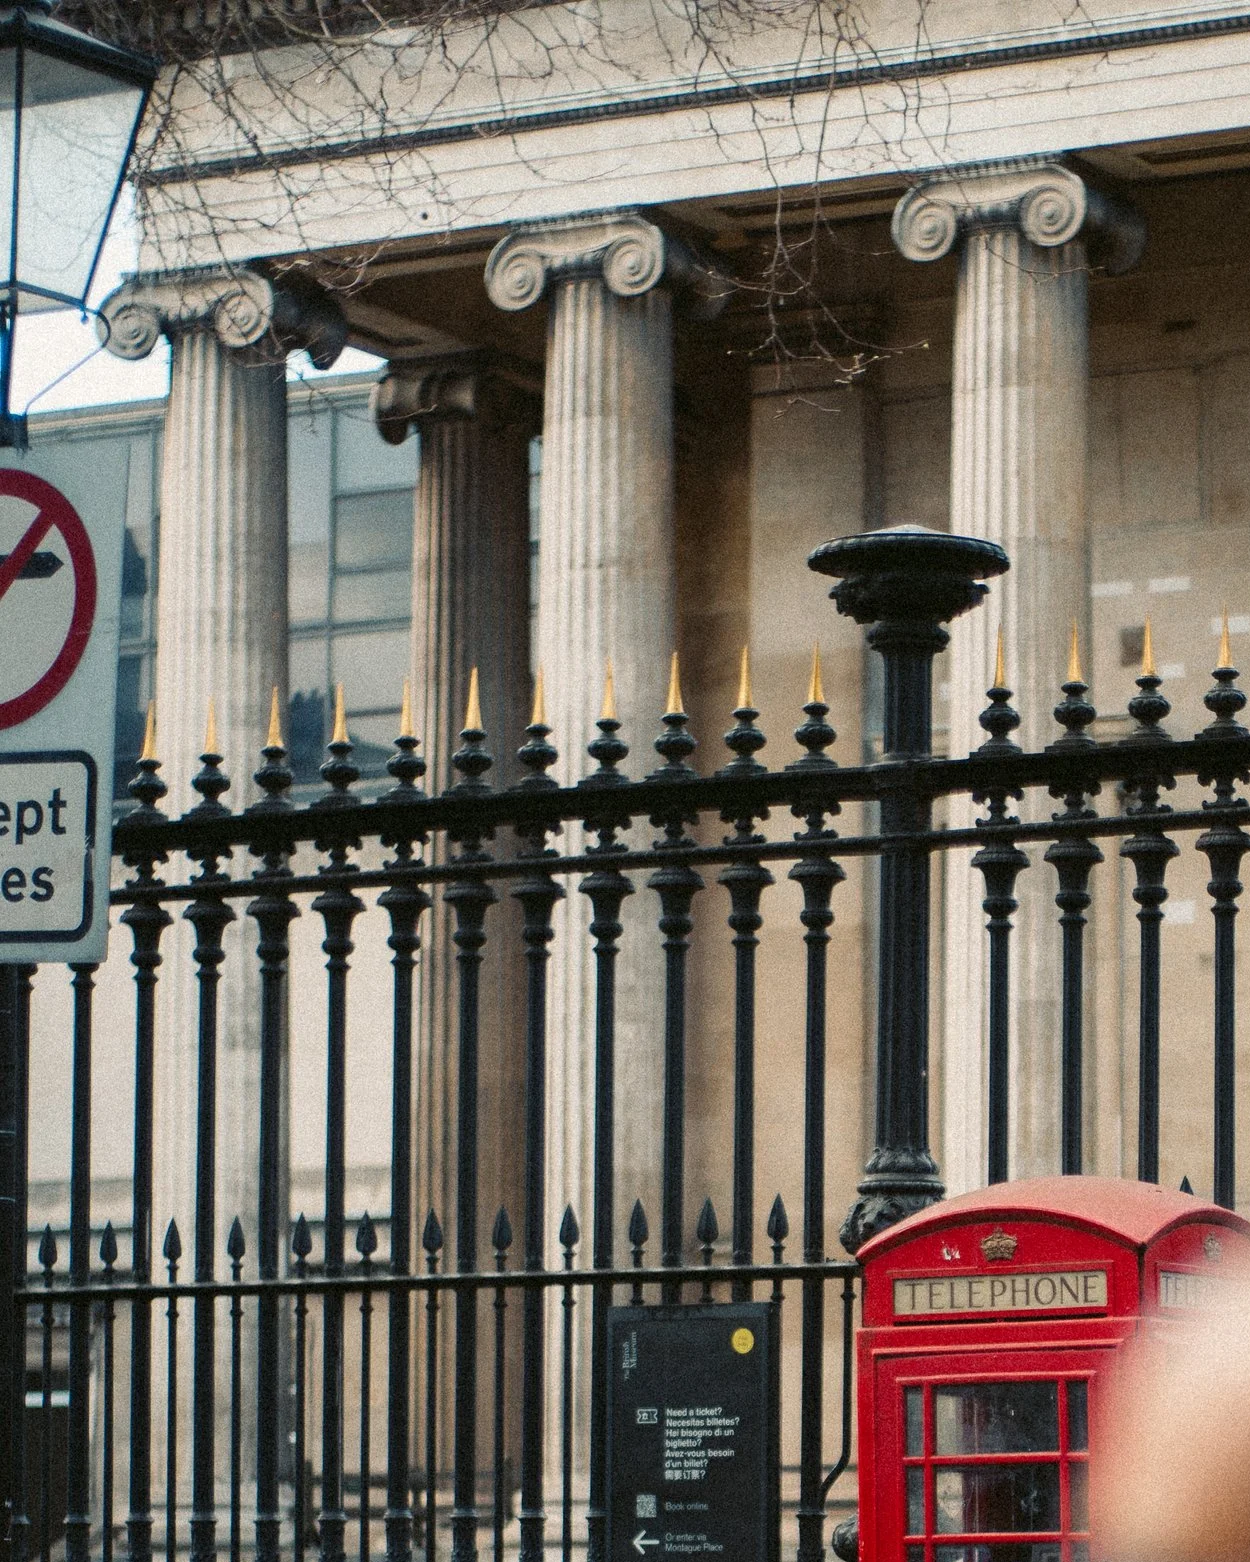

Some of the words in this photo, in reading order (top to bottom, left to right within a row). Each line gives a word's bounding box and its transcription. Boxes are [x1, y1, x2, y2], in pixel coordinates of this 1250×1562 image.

[904, 1274, 1100, 1311] TELEPHONE
[630, 1331, 638, 1369] Museum
[665, 1408, 688, 1417] Need
[696, 1407, 723, 1416] ticket?
[665, 1418, 705, 1427] Necesitas
[706, 1417, 740, 1426] billetes?
[681, 1428, 713, 1438] bisogno
[714, 1428, 722, 1436] di
[665, 1439, 702, 1449] biglietto?
[665, 1449, 706, 1457] Avez-vous
[707, 1448, 735, 1457] besoin
[665, 1459, 682, 1468] d'un
[683, 1458, 709, 1468] billet?
[665, 1501, 684, 1511] Book
[686, 1502, 709, 1510] online
[665, 1532, 674, 1541] Or
[665, 1543, 702, 1554] Montague
[703, 1543, 723, 1551] Place
